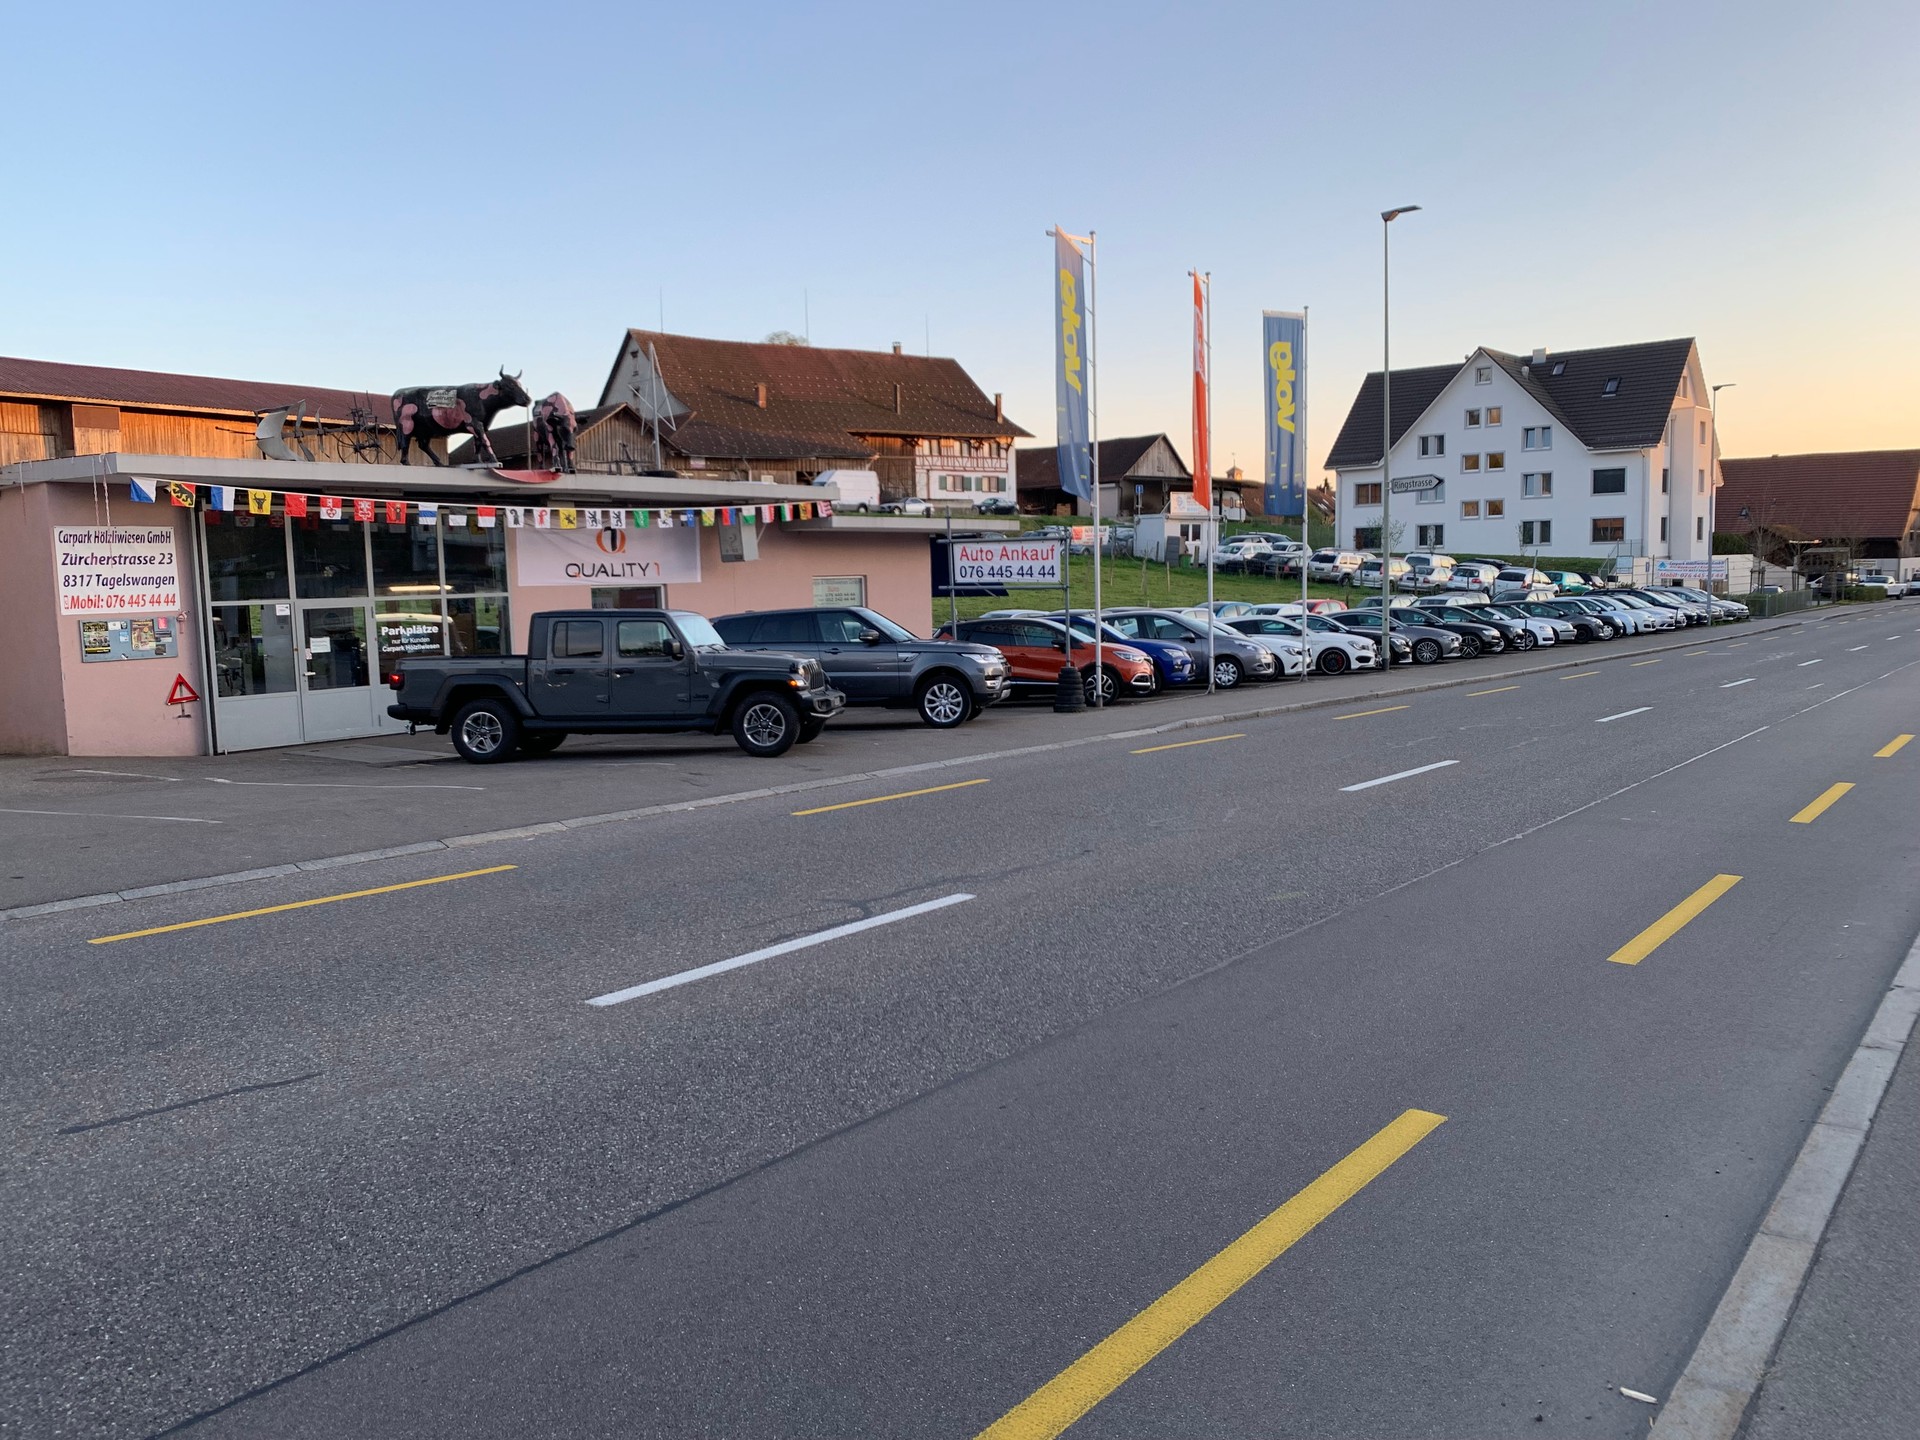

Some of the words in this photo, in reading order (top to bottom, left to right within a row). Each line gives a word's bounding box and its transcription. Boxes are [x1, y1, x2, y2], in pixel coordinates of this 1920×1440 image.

[1394, 479, 1433, 490] Ringstrasse
[58, 530, 93, 547] Carpark
[93, 530, 146, 544] Hölzliwiesen
[147, 530, 171, 544] GmbH
[61, 552, 156, 566] Zürcherstrasse
[158, 552, 173, 565] 23
[960, 545, 994, 562] Auto
[999, 544, 1055, 561] Ankauf
[565, 562, 650, 578] QUALITY
[653, 562, 661, 577] 1
[960, 565, 984, 578] 076
[987, 565, 1013, 578] 445
[1016, 565, 1034, 578] 44
[1037, 564, 1056, 578] 44
[63, 574, 93, 588] 8317
[95, 573, 175, 590] Tagelswangen
[70, 594, 104, 610] Mobil:
[106, 594, 126, 608] 076
[127, 594, 147, 607] 445
[149, 593, 162, 607] 44
[163, 593, 176, 606] 44
[381, 625, 439, 636] Parkplätze
